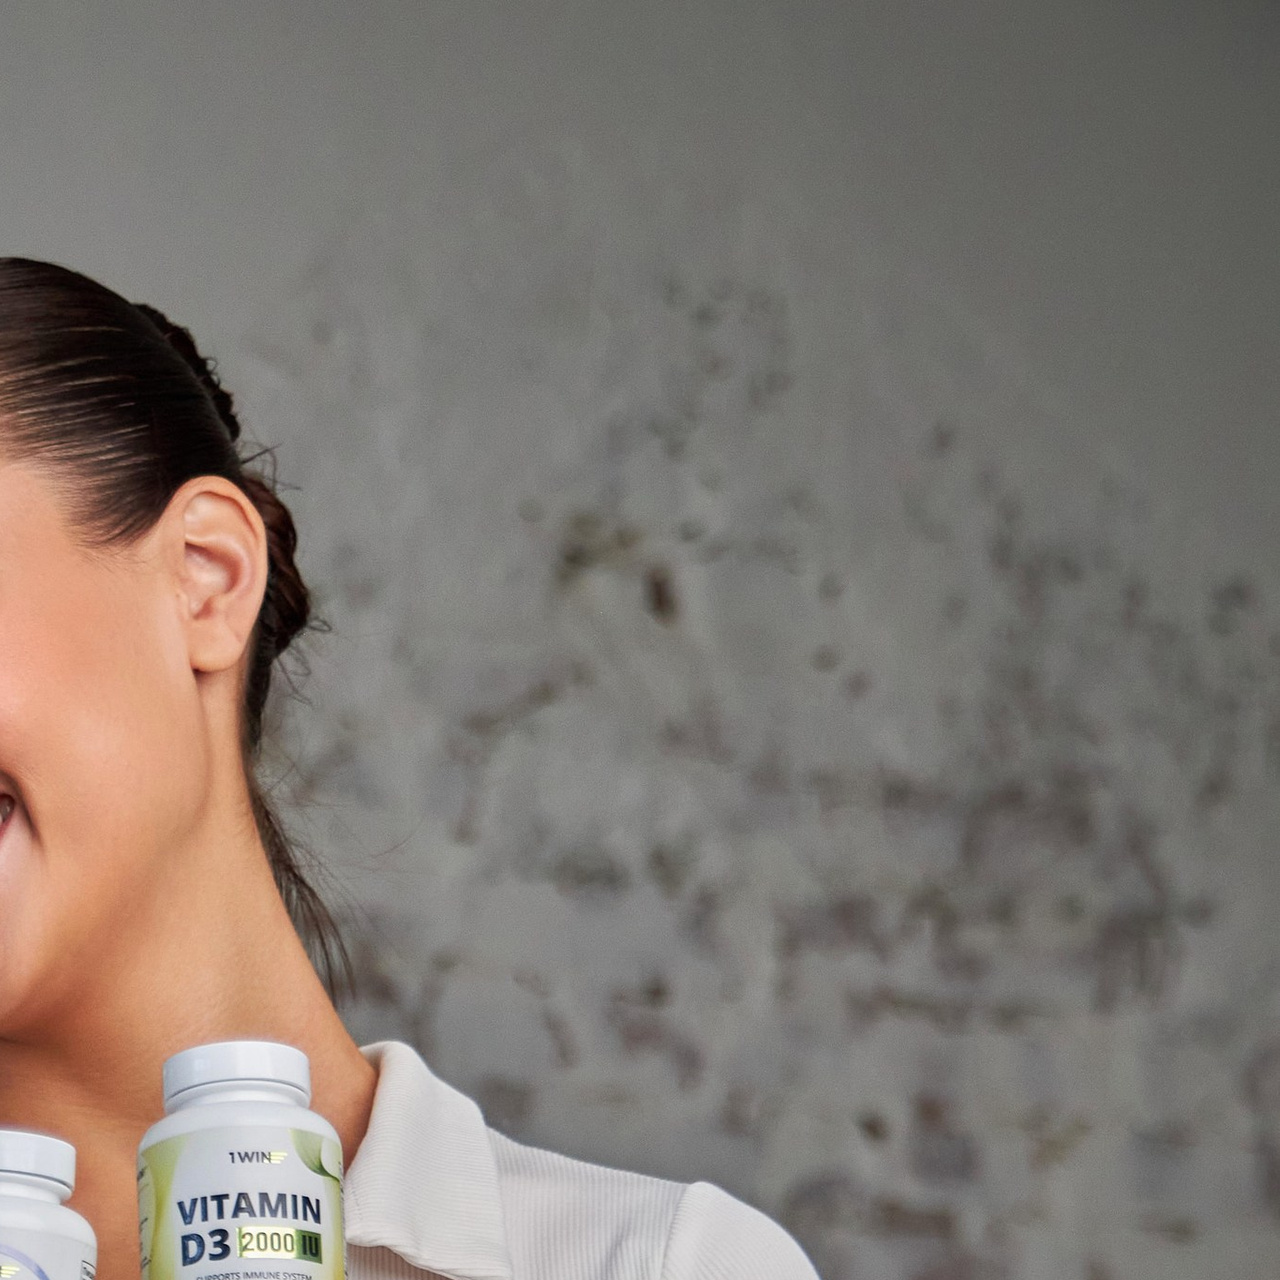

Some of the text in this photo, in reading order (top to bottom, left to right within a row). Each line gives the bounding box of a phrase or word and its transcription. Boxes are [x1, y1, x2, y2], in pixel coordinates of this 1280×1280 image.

[177, 1192, 322, 1226] VITAMIN
[181, 1228, 319, 1267] D3 2000 IU
[242, 1271, 281, 1280] IMMUNE
